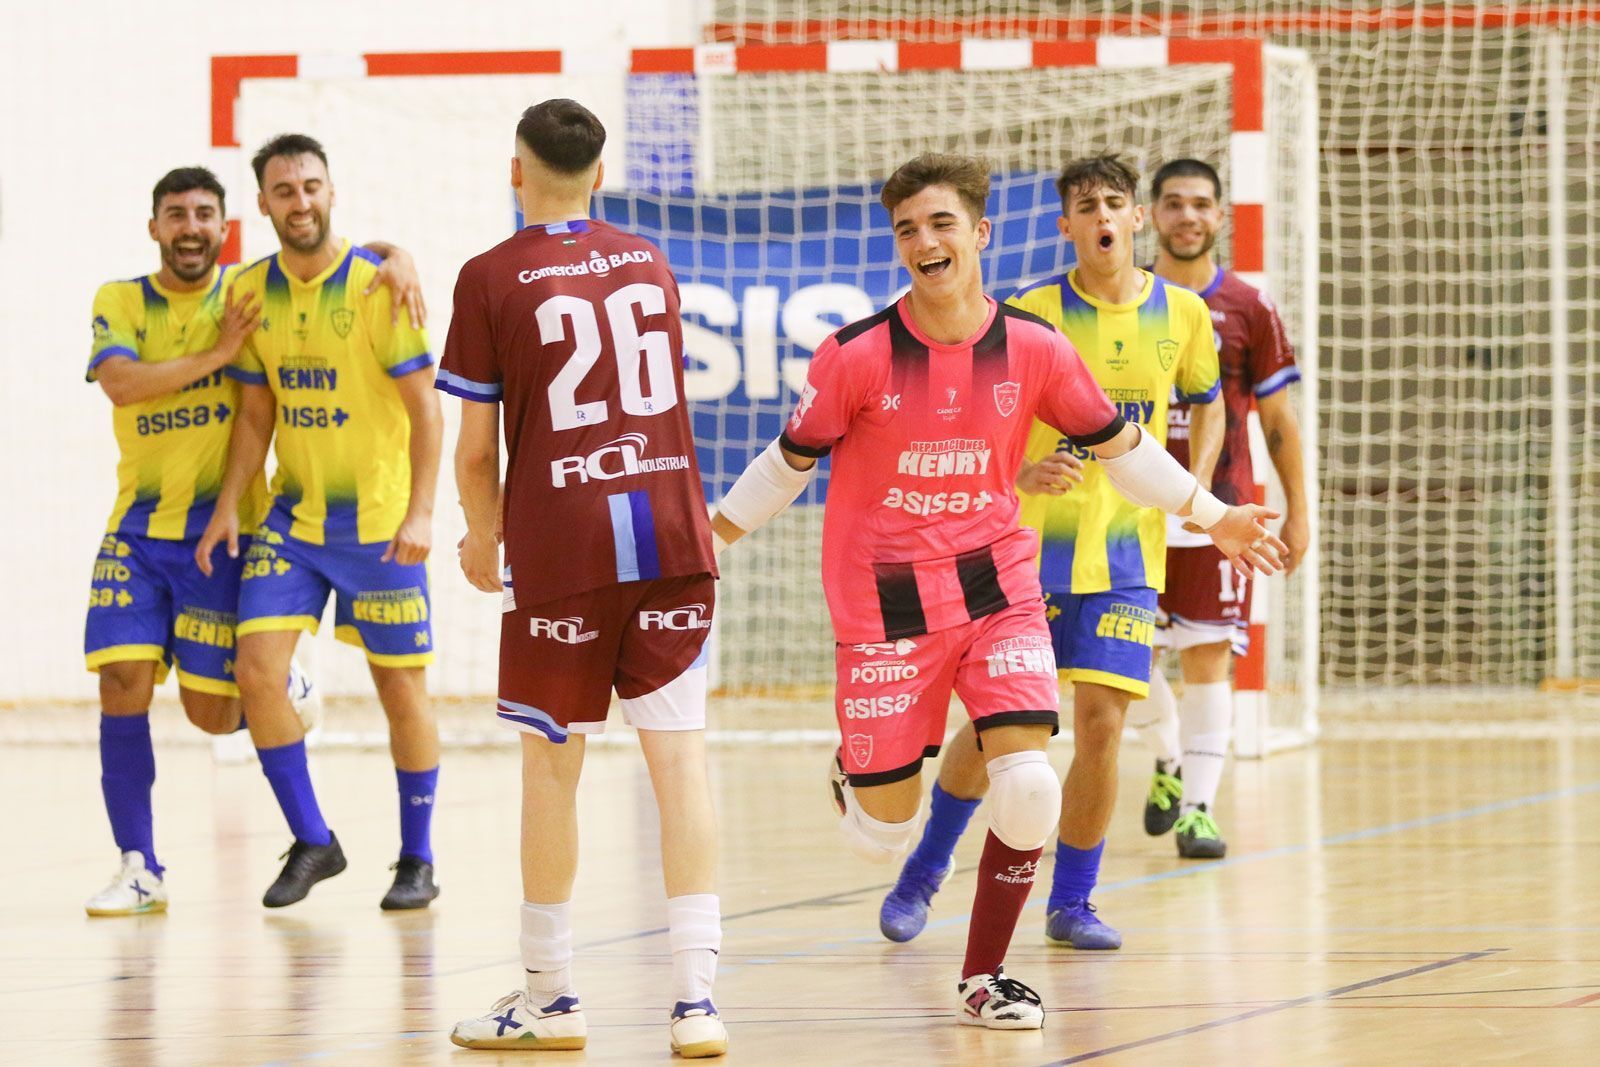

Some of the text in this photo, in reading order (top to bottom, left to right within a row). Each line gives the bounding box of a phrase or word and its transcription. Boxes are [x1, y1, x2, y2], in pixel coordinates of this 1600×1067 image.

[518, 261, 589, 284] Comercial
[535, 283, 678, 431] 26
[911, 438, 986, 453] REPARACIONES
[898, 448, 991, 478] HENRY
[174, 613, 235, 649] HENR
[850, 664, 919, 684] POTITO
